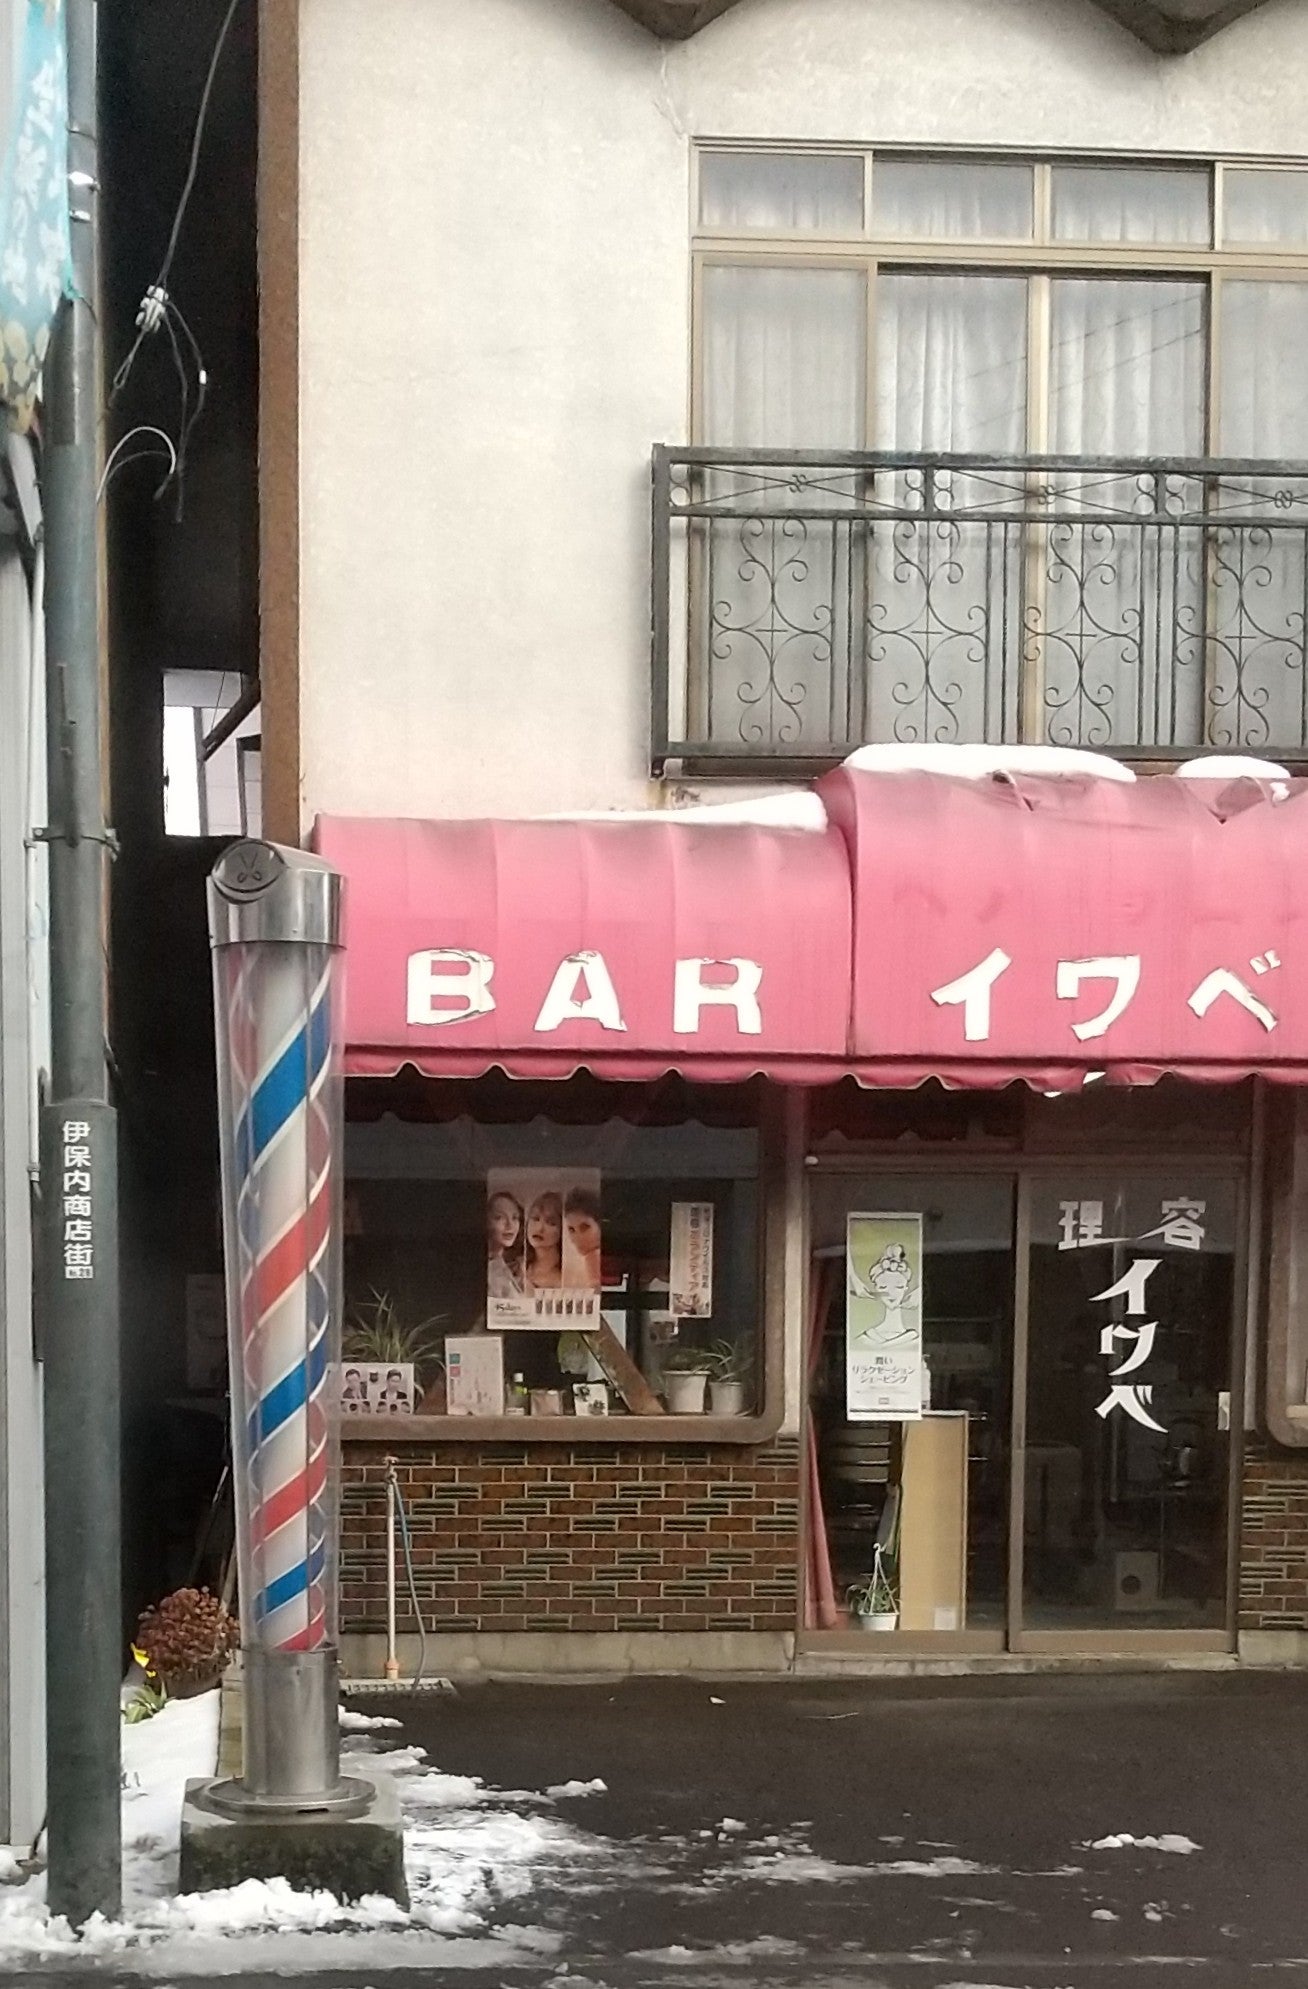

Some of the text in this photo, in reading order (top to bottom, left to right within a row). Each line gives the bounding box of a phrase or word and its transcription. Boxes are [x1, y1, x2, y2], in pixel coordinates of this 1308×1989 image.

[406, 947, 1281, 1041] BAR イワベ
[63, 1120, 94, 1265] 伊保内商店街
[1058, 1196, 1206, 1252] 理容
[1089, 1259, 1168, 1433] イワベ
